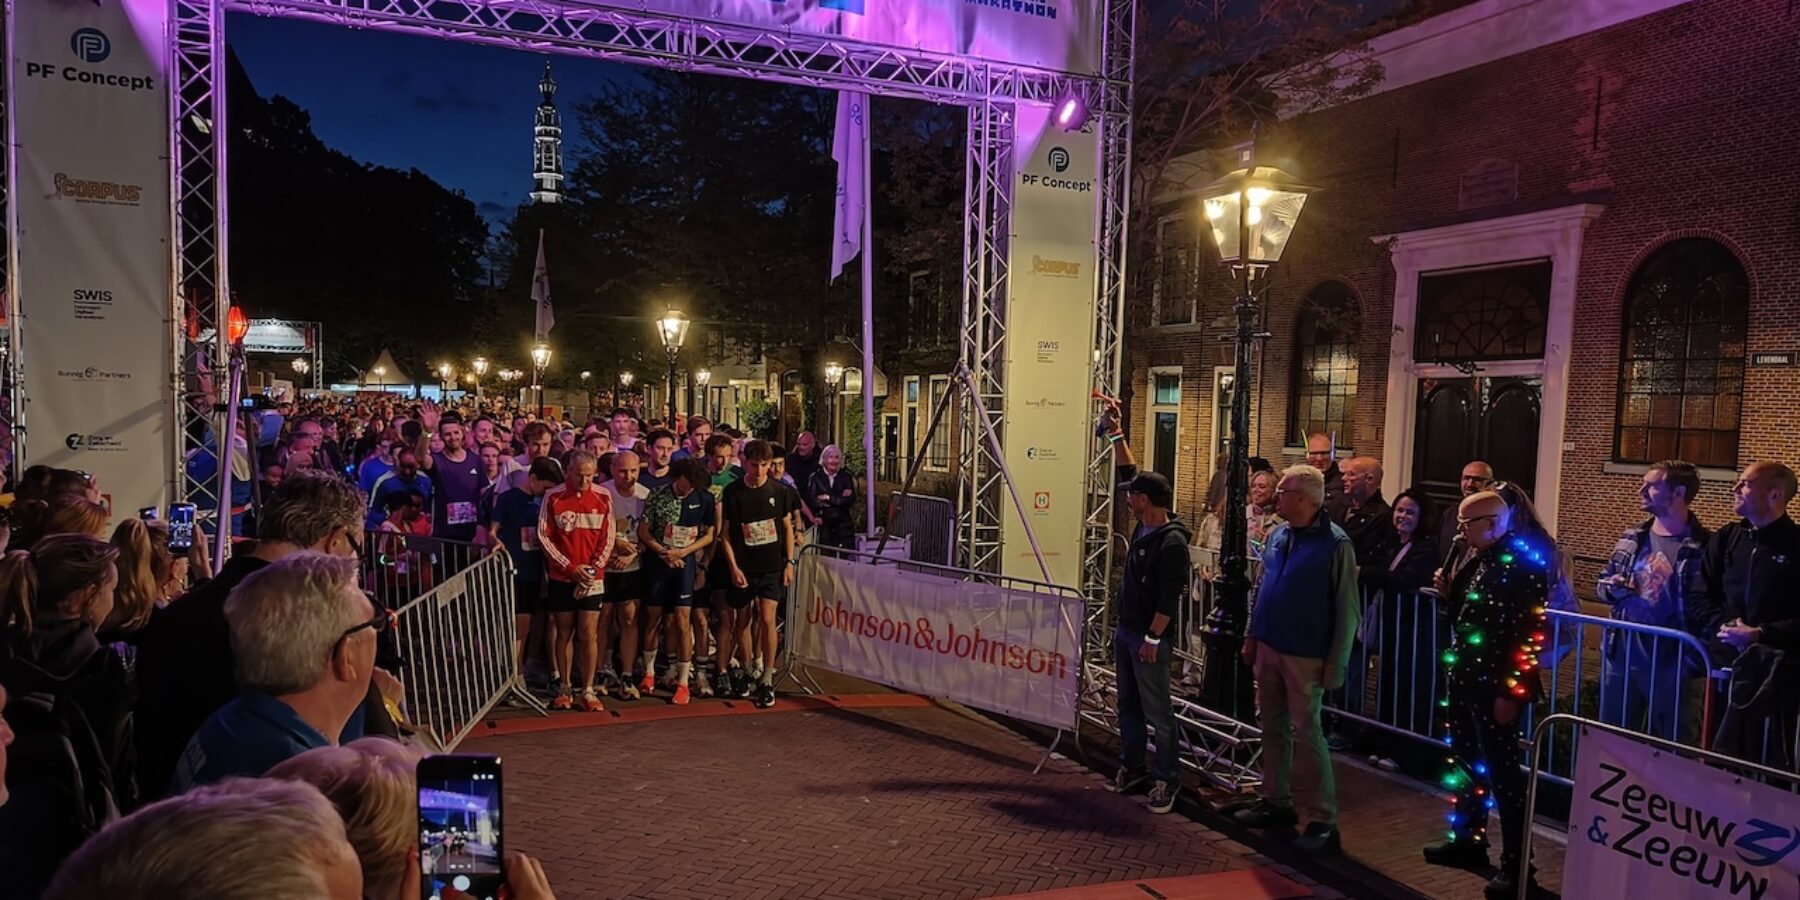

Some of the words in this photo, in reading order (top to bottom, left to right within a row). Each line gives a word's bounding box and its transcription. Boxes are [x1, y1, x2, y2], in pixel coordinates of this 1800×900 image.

[965, 0, 1057, 19] RATHON
[26, 62, 56, 78] PF
[62, 67, 154, 91] Concept
[62, 179, 142, 201] CORPUS
[1022, 174, 1038, 186] PF
[1042, 176, 1091, 192] Concept
[73, 289, 112, 302] SWIS
[1037, 341, 1060, 350] SWIS
[806, 596, 1066, 680] Johnson&Johnson
[1590, 763, 1737, 848] Zeeuw
[1612, 813, 1768, 900] Zeeuw
